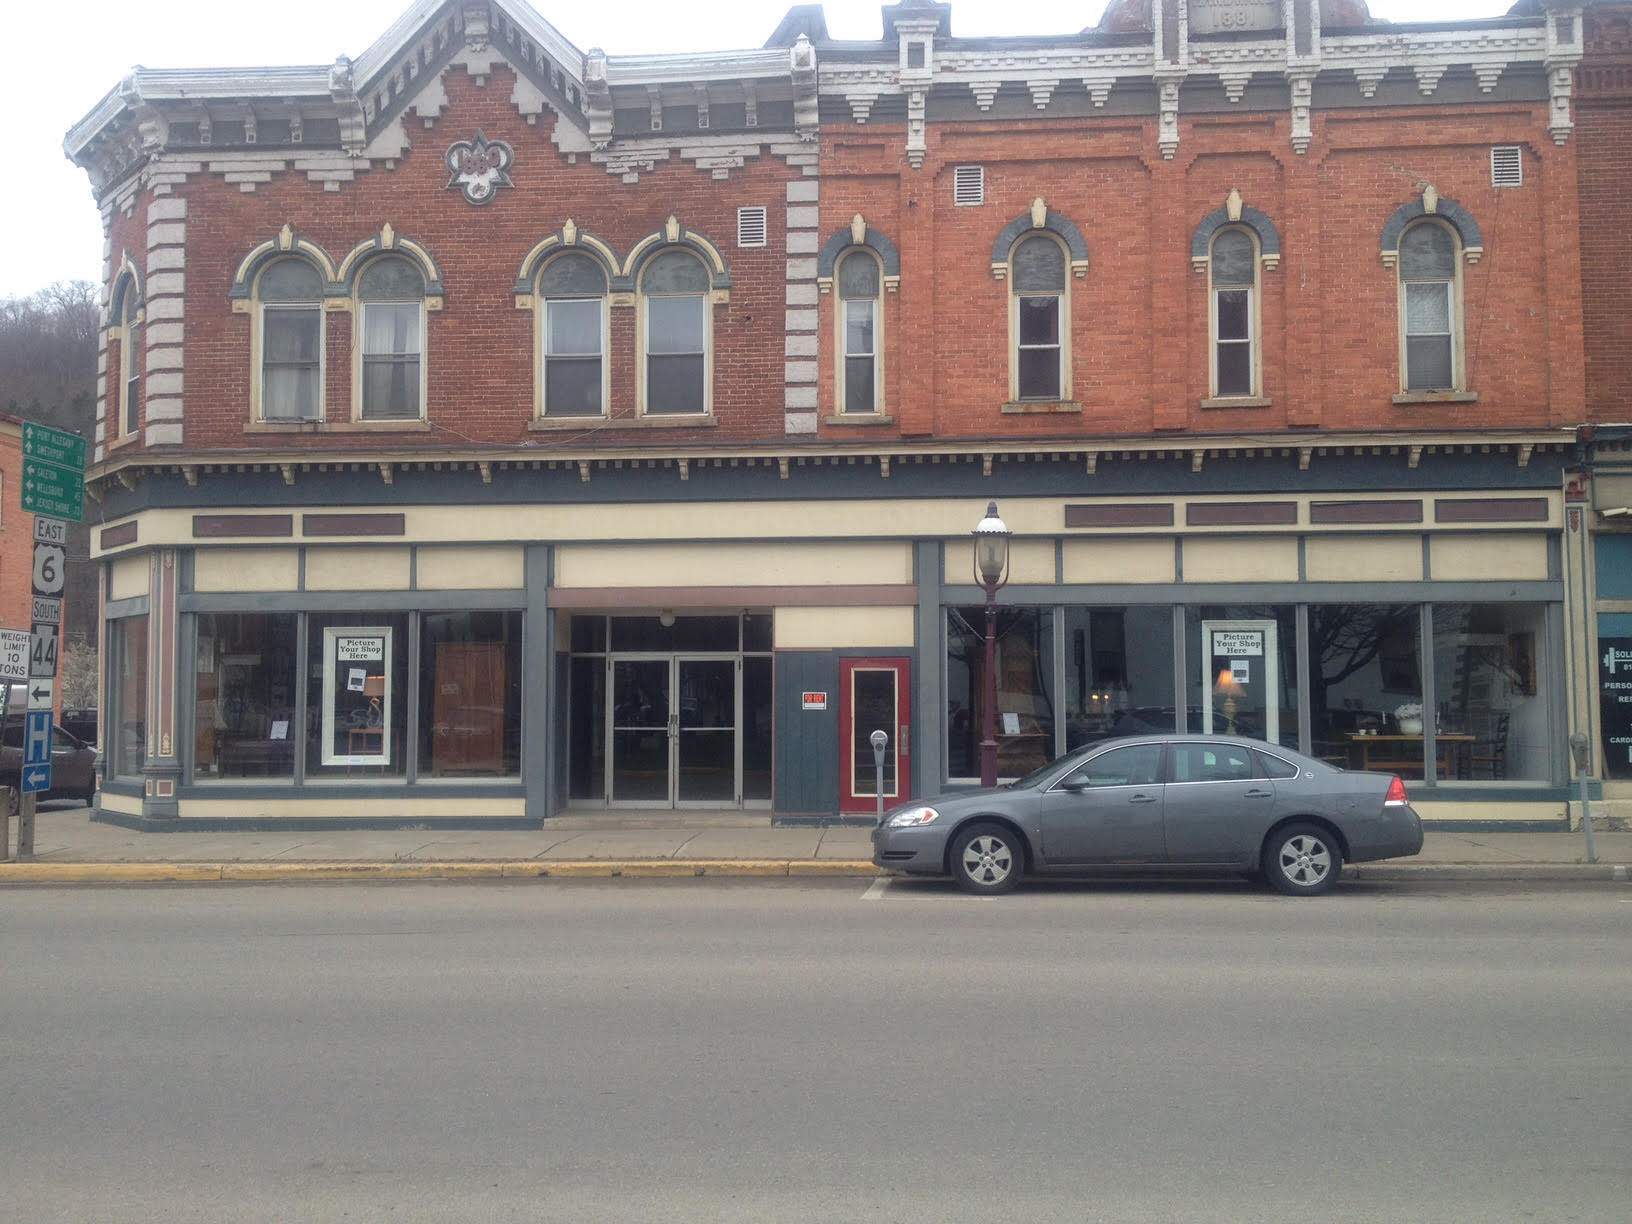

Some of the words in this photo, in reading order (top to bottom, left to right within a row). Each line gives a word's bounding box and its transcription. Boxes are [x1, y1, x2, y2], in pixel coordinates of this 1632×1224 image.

[38, 521, 62, 539] EAST
[42, 556, 55, 582] 6
[34, 601, 59, 619] SOUTH
[4, 642, 26, 651] LIMIT
[33, 637, 55, 666] 44
[361, 646, 382, 654] Shop
[1239, 640, 1260, 648] Shop
[8, 653, 20, 663] 10
[28, 714, 49, 761] H
